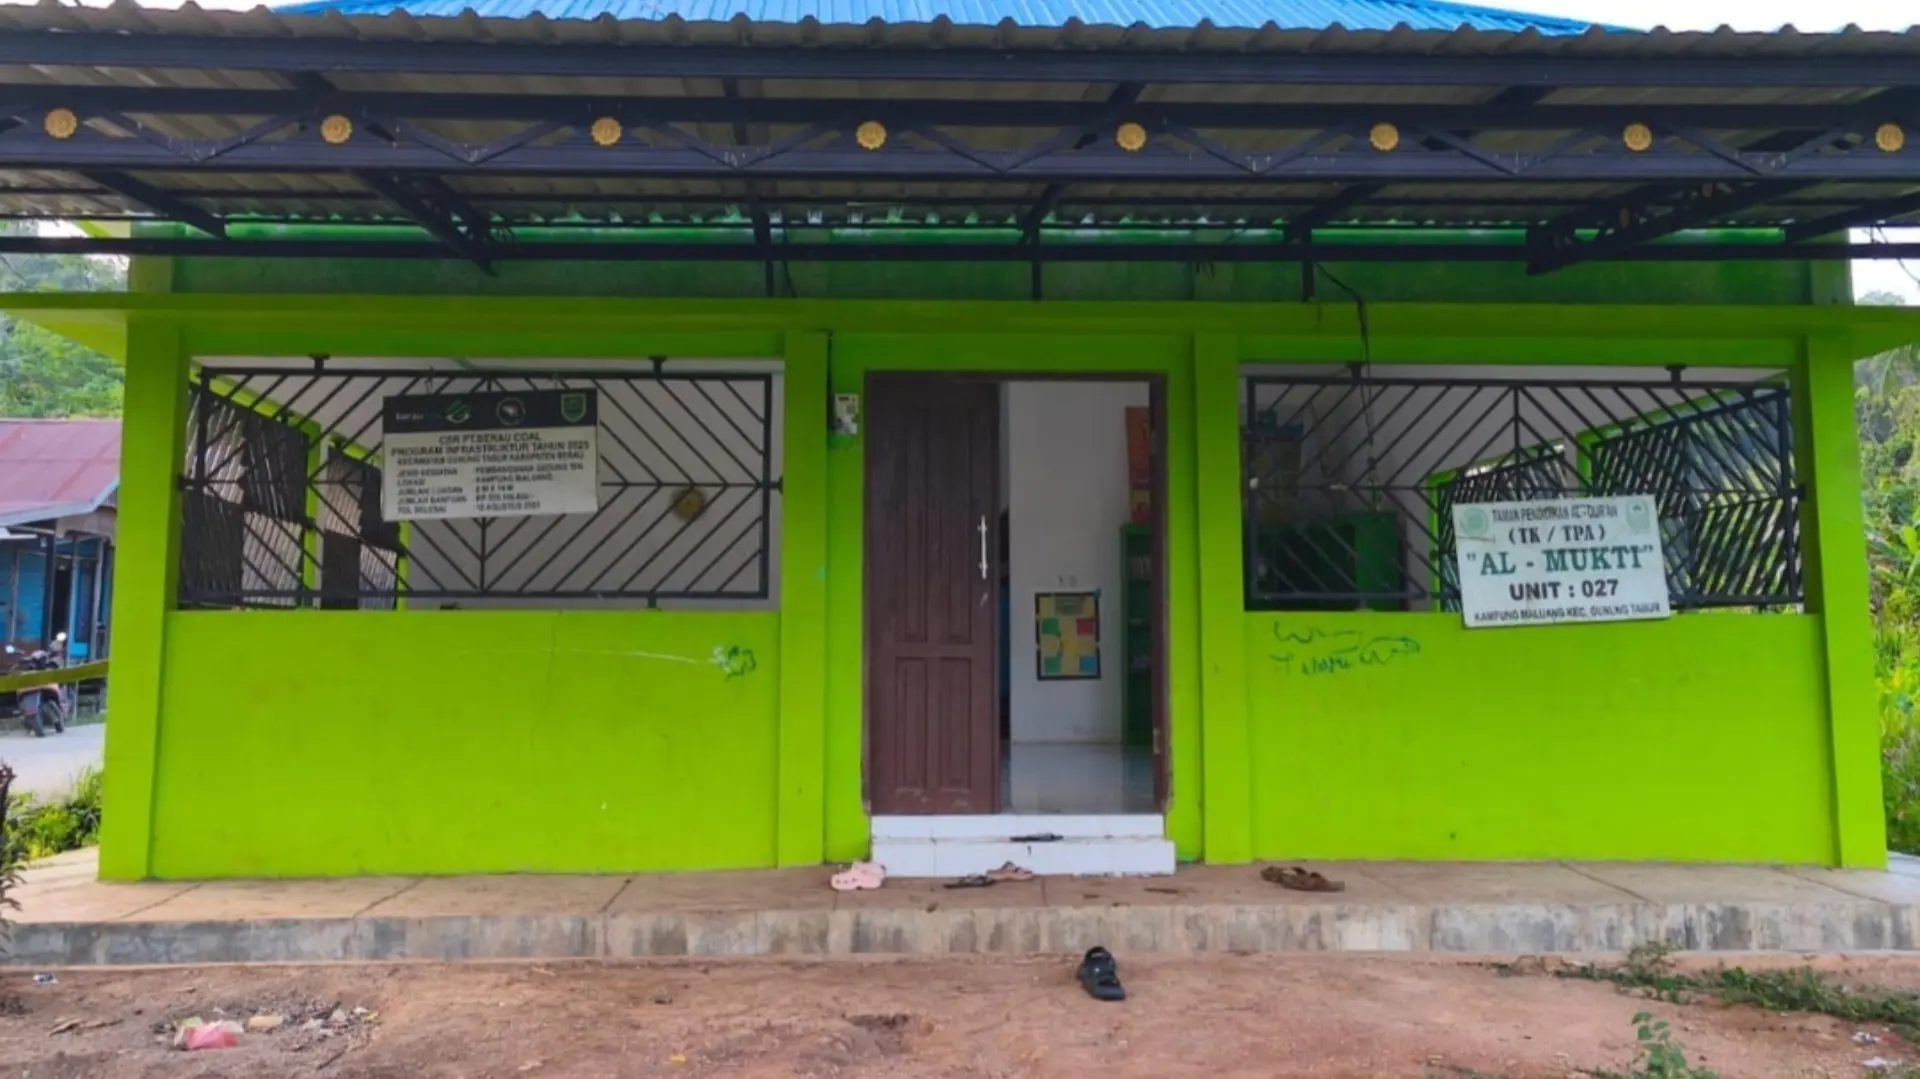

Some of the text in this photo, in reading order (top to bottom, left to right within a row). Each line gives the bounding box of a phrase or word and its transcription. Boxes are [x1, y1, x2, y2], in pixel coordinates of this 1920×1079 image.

[513, 431, 540, 442] COAL
[390, 446, 444, 456] PROGRAM
[446, 443, 529, 455] INFRASTRUKTUR
[532, 441, 565, 451] TAHUN
[1548, 525, 1556, 542] /
[1509, 579, 1619, 601] UNIT : 027
[1474, 611, 1519, 621] KAMPUNG
[1521, 608, 1565, 620] MALUANG
[1590, 604, 1629, 616] GUNUNG
